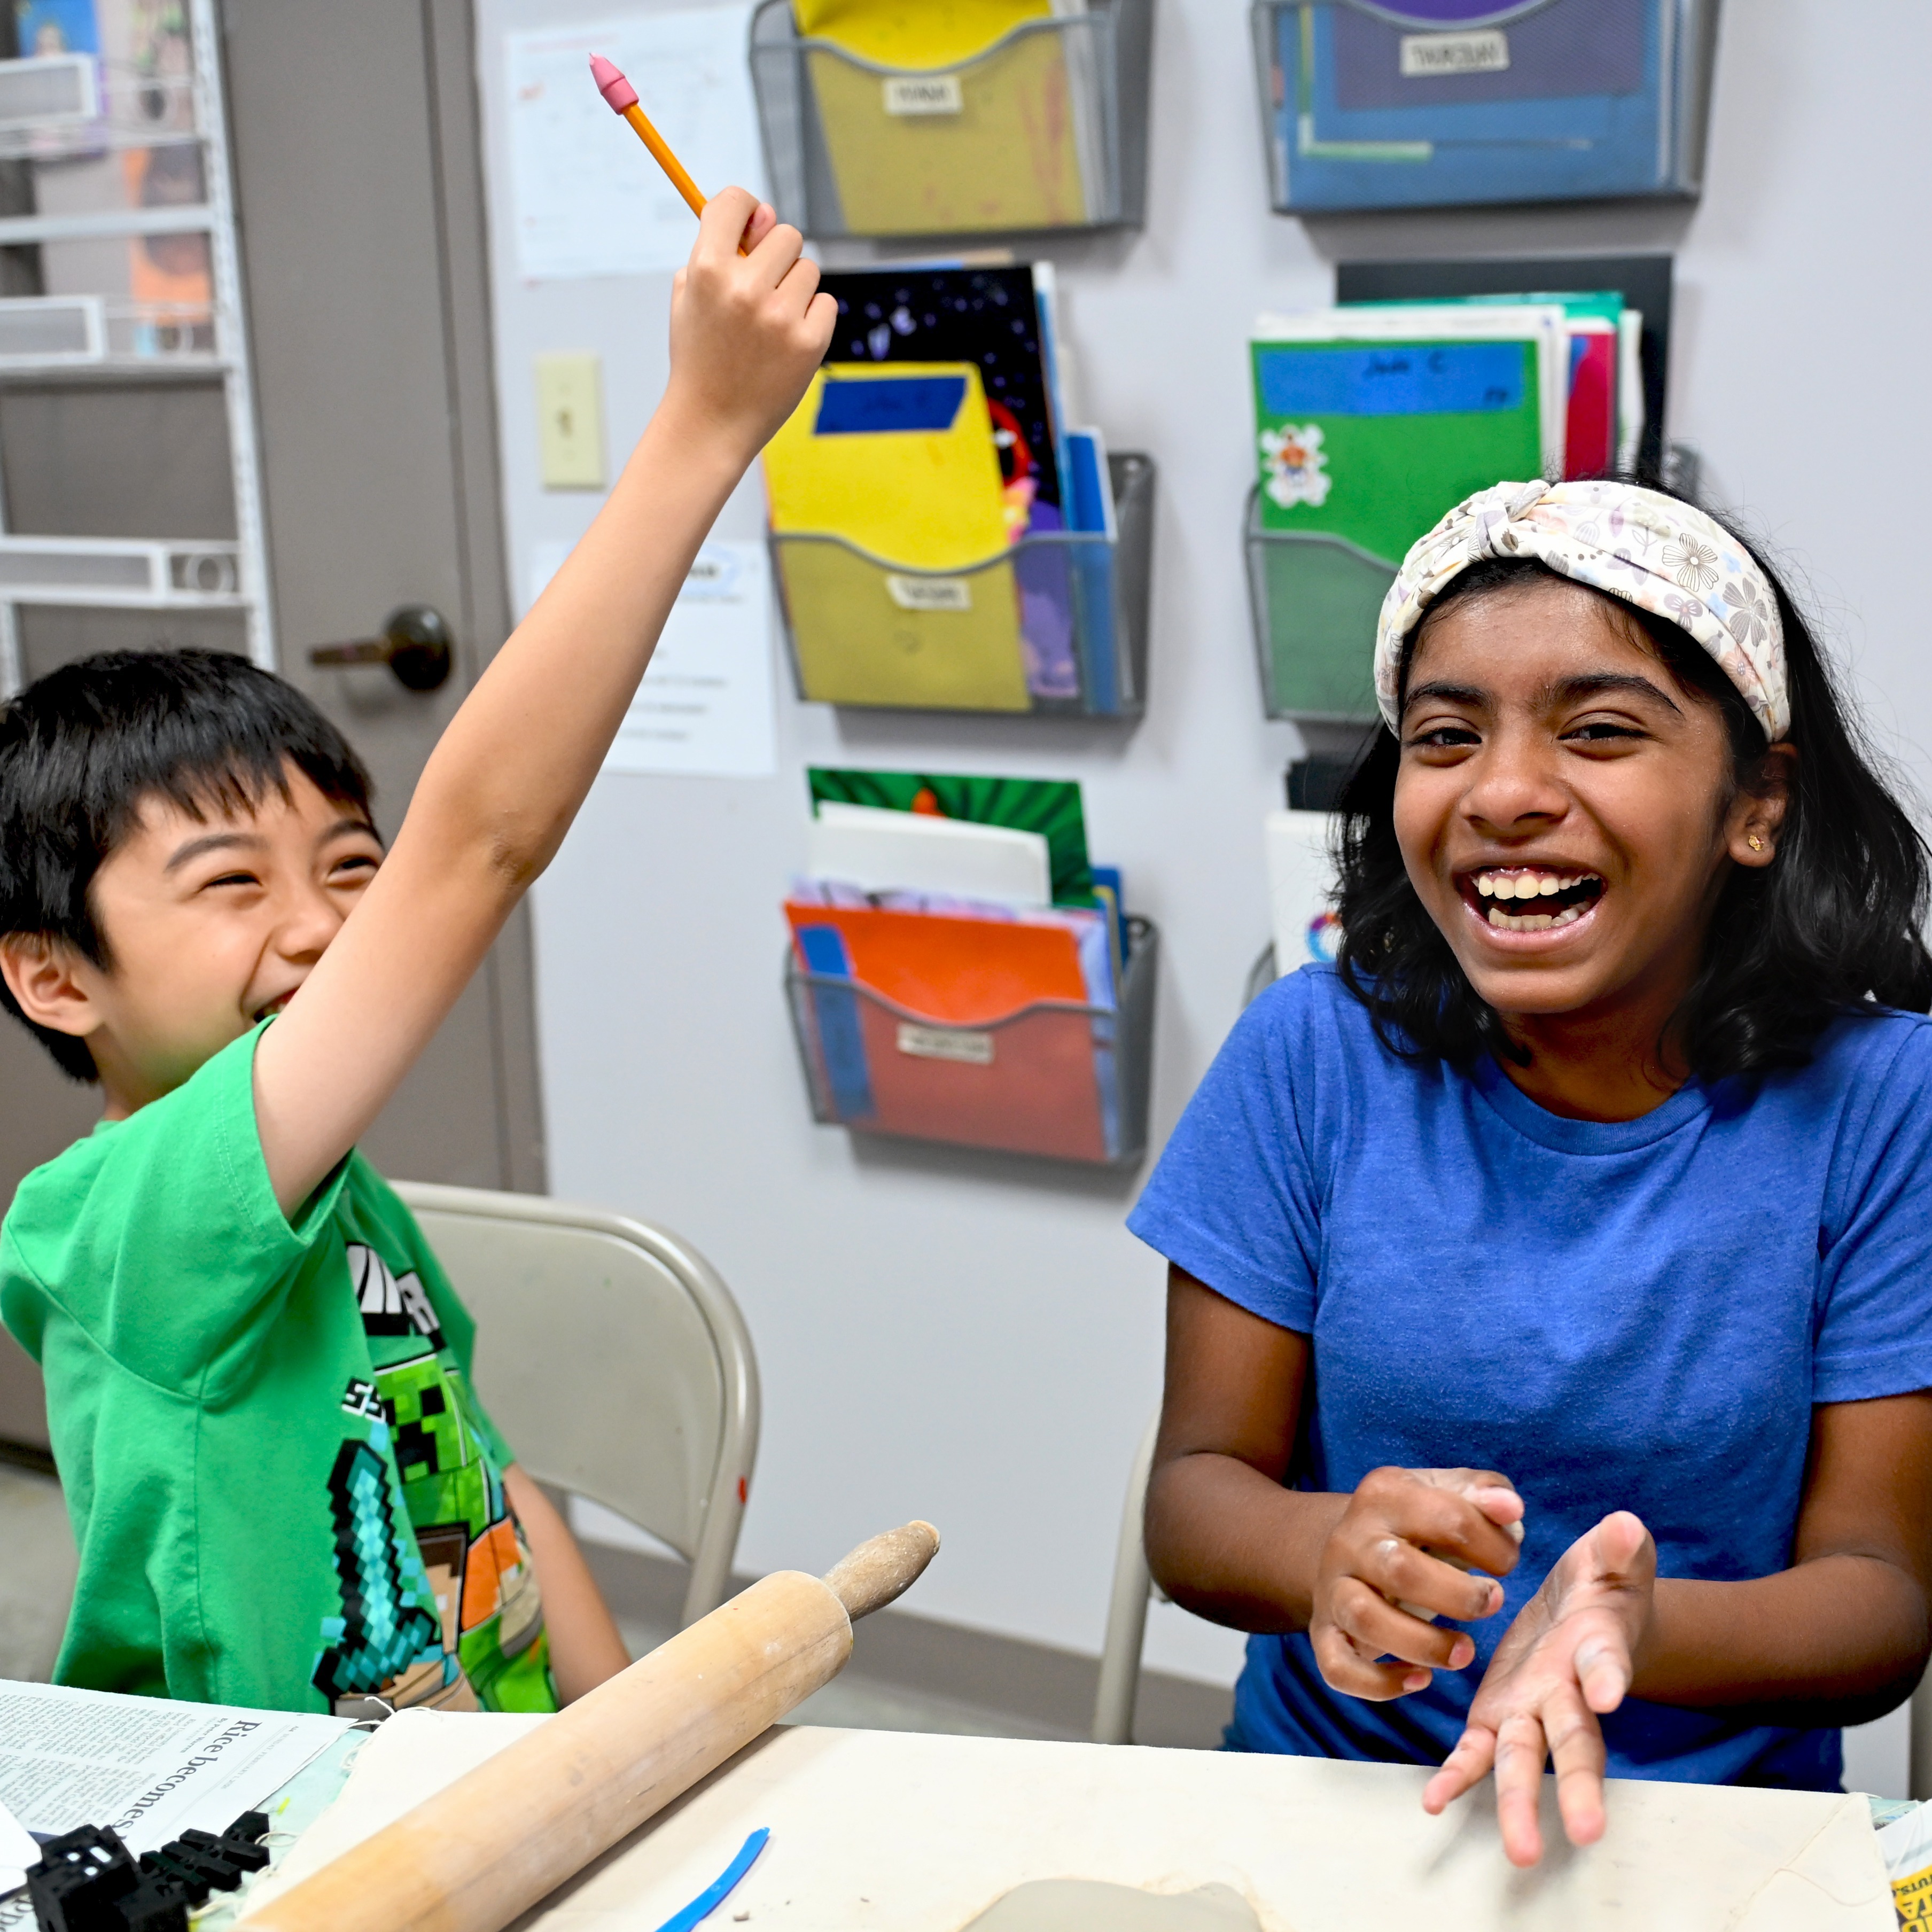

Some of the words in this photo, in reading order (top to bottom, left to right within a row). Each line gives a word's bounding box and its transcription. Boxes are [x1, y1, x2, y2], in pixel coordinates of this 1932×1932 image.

[49, 1716, 63, 1725] part
[89, 1714, 111, 1725] World
[146, 1713, 161, 1721] The
[169, 1712, 185, 1720] host
[172, 1713, 191, 1726] named
[52, 1715, 77, 1730] campus
[108, 1716, 136, 1734] programs
[109, 1719, 123, 1727] and
[127, 1717, 146, 1728] watch
[145, 1719, 165, 1731] FIFA
[157, 1720, 172, 1728] city
[180, 1718, 197, 1727] Rice
[17, 1729, 37, 1739] help
[48, 1731, 63, 1739] run
[79, 1724, 104, 1740] students
[119, 1722, 148, 1741] university
[184, 1726, 205, 1741] WRITER
[200, 1723, 221, 1736] Peter
[96, 1735, 110, 1743] and
[129, 1731, 151, 1743] World
[133, 1729, 161, 1748] supporter
[146, 1732, 167, 1746] official
[153, 1727, 185, 1747] University
[201, 1719, 263, 1754] Rice
[262, 1733, 290, 1751] SUNDAY,
[14, 1736, 37, 1750] World
[104, 1742, 122, 1754] plans
[179, 1736, 205, 1753] Warren
[59, 1744, 76, 1755] pitch
[77, 1744, 98, 1757] soccer
[123, 1746, 151, 1764] Houston
[145, 1747, 160, 1755] has
[133, 1755, 150, 1765] been
[235, 1751, 268, 1775] FEBRUARY
[53, 1763, 77, 1776] World
[17, 1771, 43, 1787] highest
[38, 1776, 58, 1786] Cup
[76, 1771, 97, 1783] North
[26, 1787, 44, 1797] host
[52, 1783, 81, 1802] America
[73, 1780, 96, 1793] World
[78, 1783, 100, 1797] college
[109, 1754, 220, 1829] becomes
[58, 1794, 77, 1804] Cup
[88, 1790, 103, 1798] the
[48, 1804, 65, 1816] host
[76, 1799, 92, 1810] first
[89, 1808, 104, 1817] the
